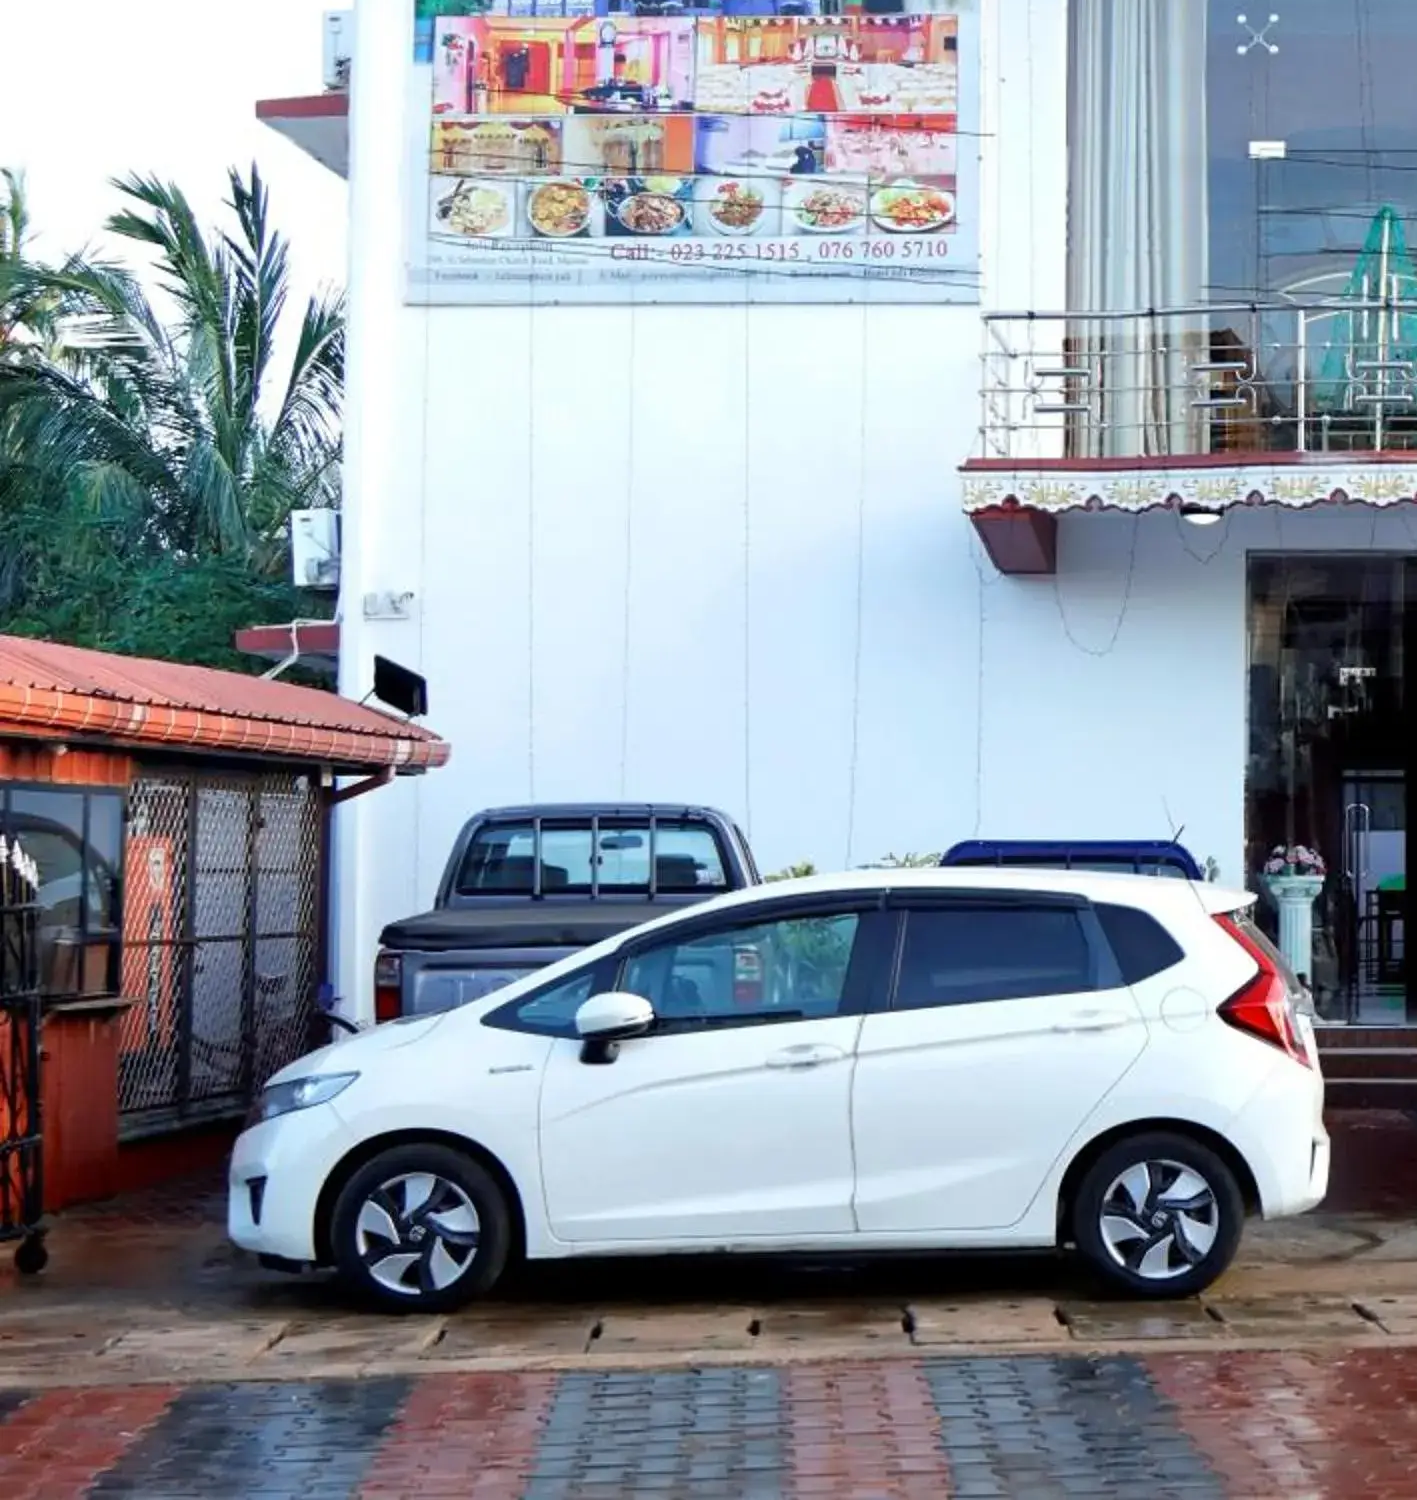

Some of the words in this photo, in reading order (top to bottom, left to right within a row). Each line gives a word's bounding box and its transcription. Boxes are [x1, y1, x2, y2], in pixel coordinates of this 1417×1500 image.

[670, 243, 704, 261] 023
[712, 243, 746, 261] 225
[755, 243, 800, 260] 1515
[819, 241, 853, 258] 076
[860, 241, 895, 258] 760
[902, 240, 948, 258] 5710
